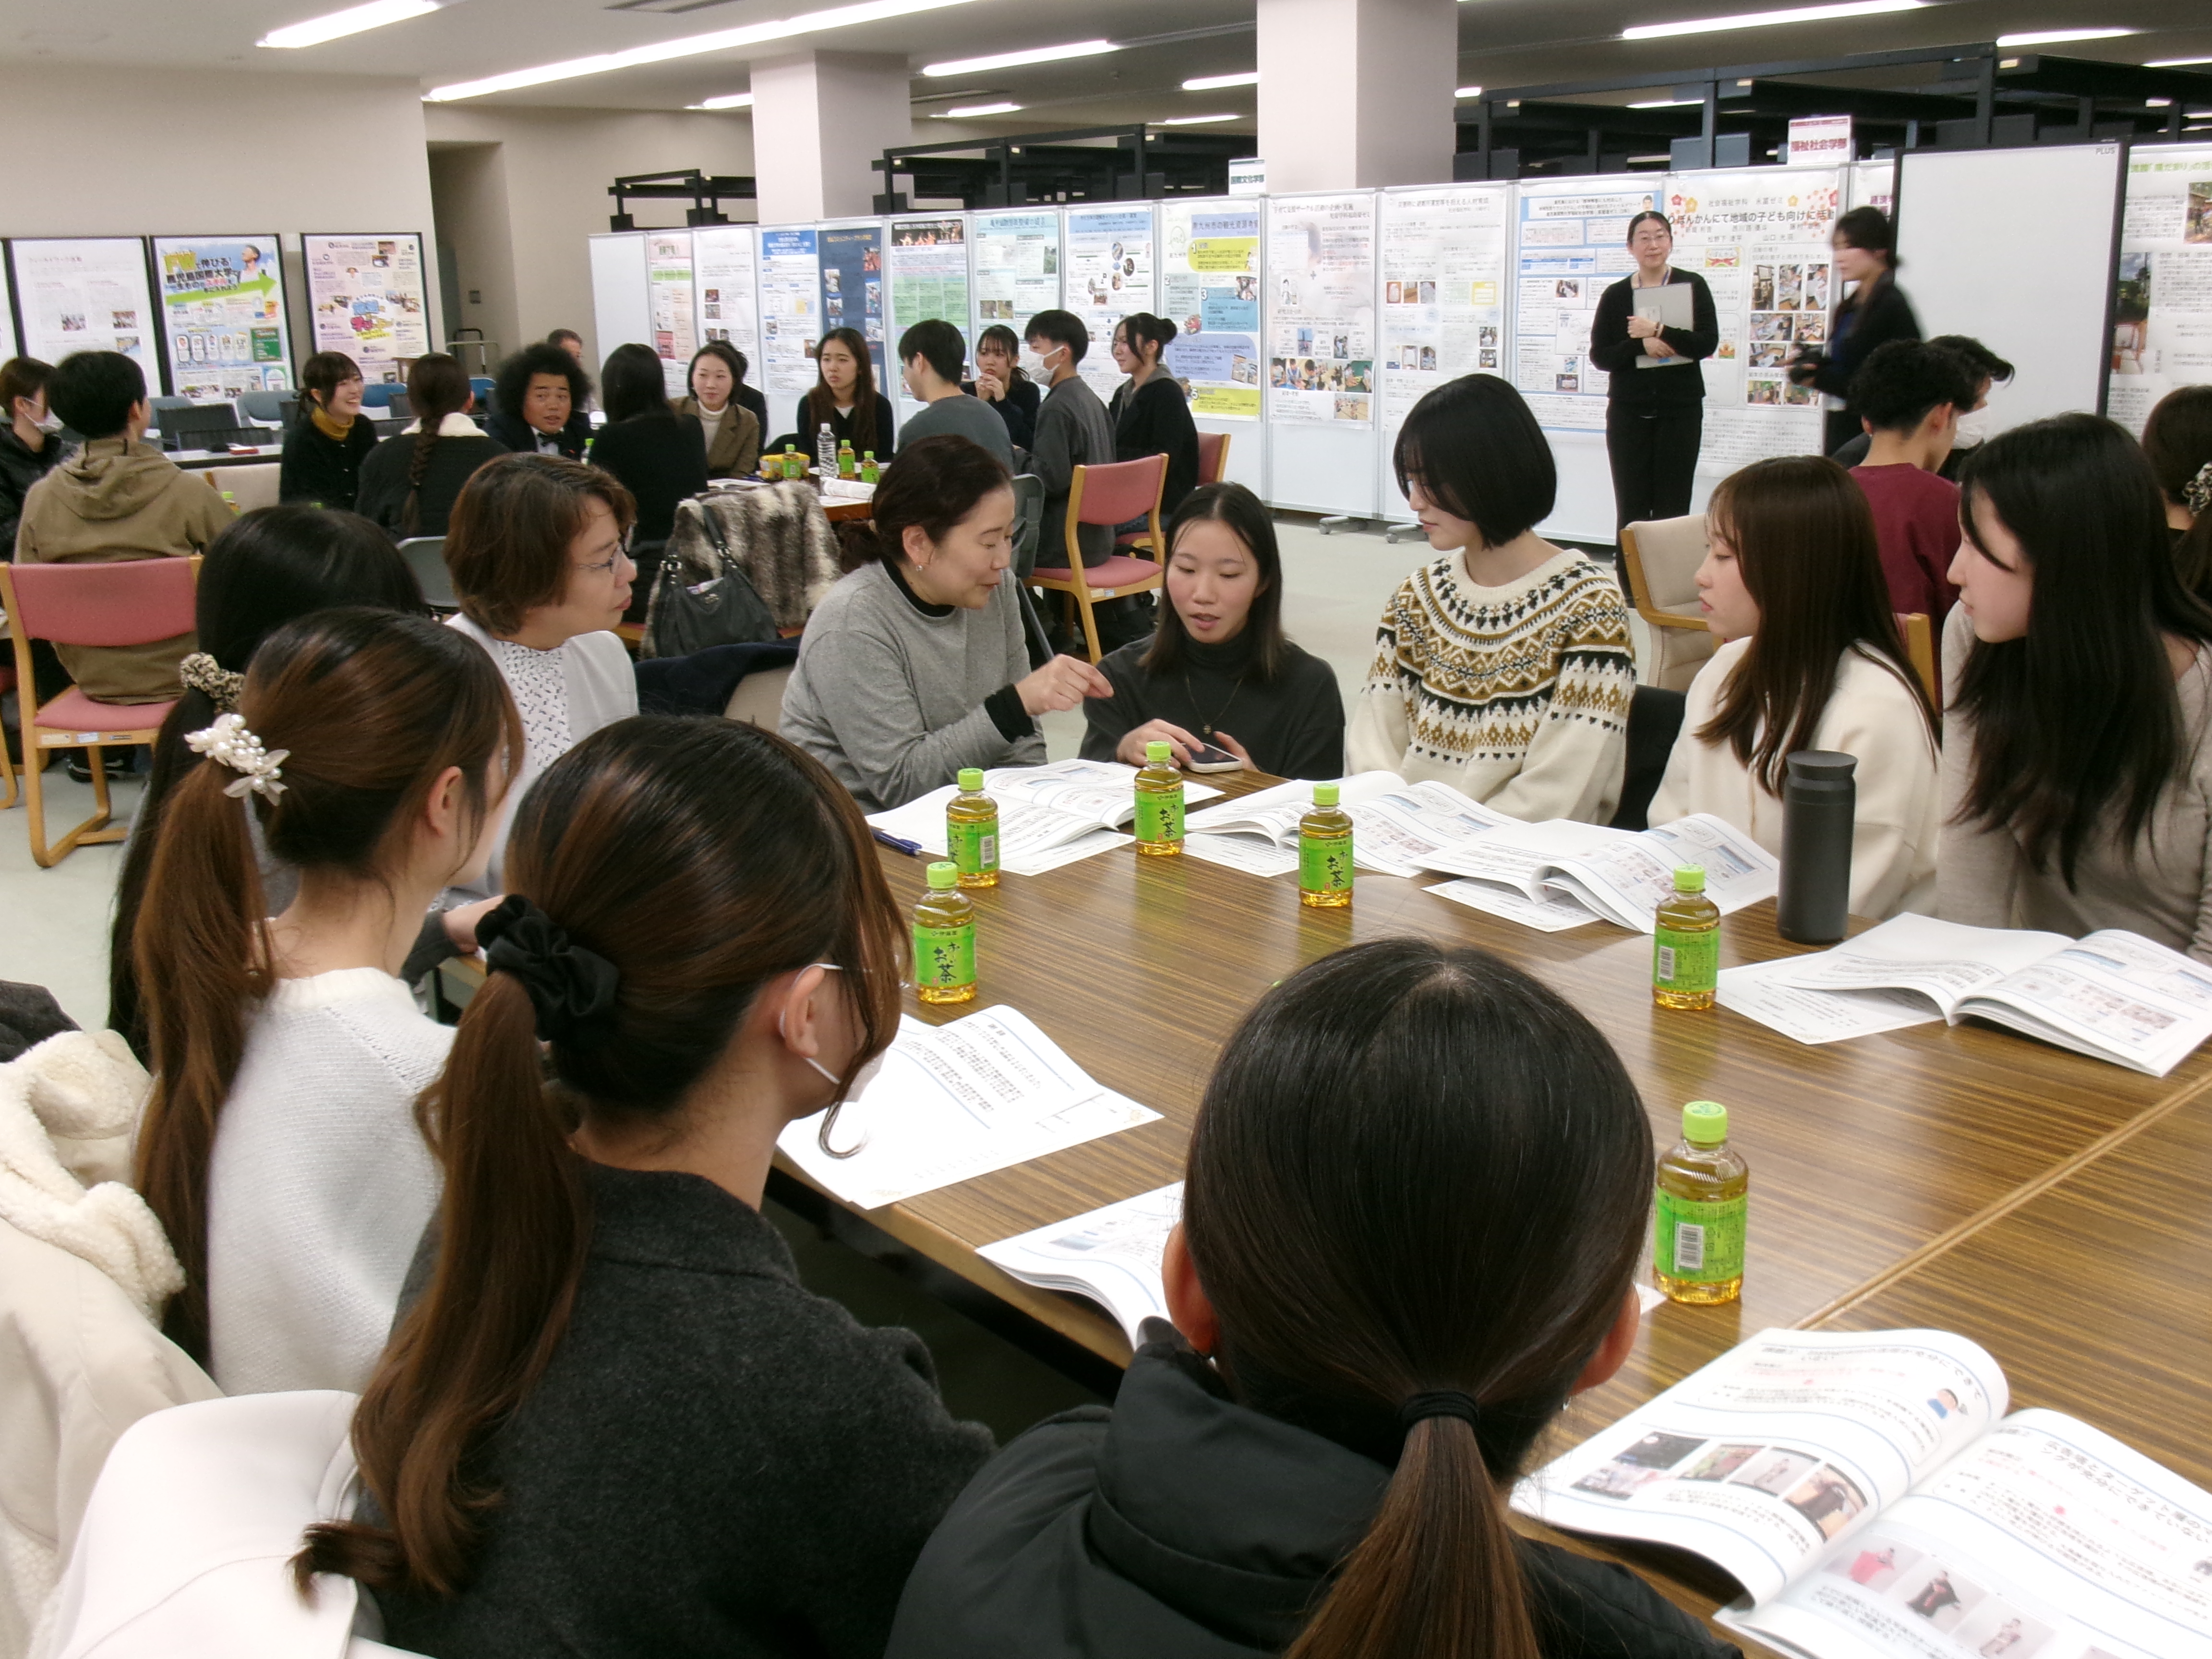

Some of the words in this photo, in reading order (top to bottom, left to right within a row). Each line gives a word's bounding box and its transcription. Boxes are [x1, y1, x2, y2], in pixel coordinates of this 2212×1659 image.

[1791, 138, 1847, 152] 福祉社会学部
[933, 946, 957, 984] お茶
